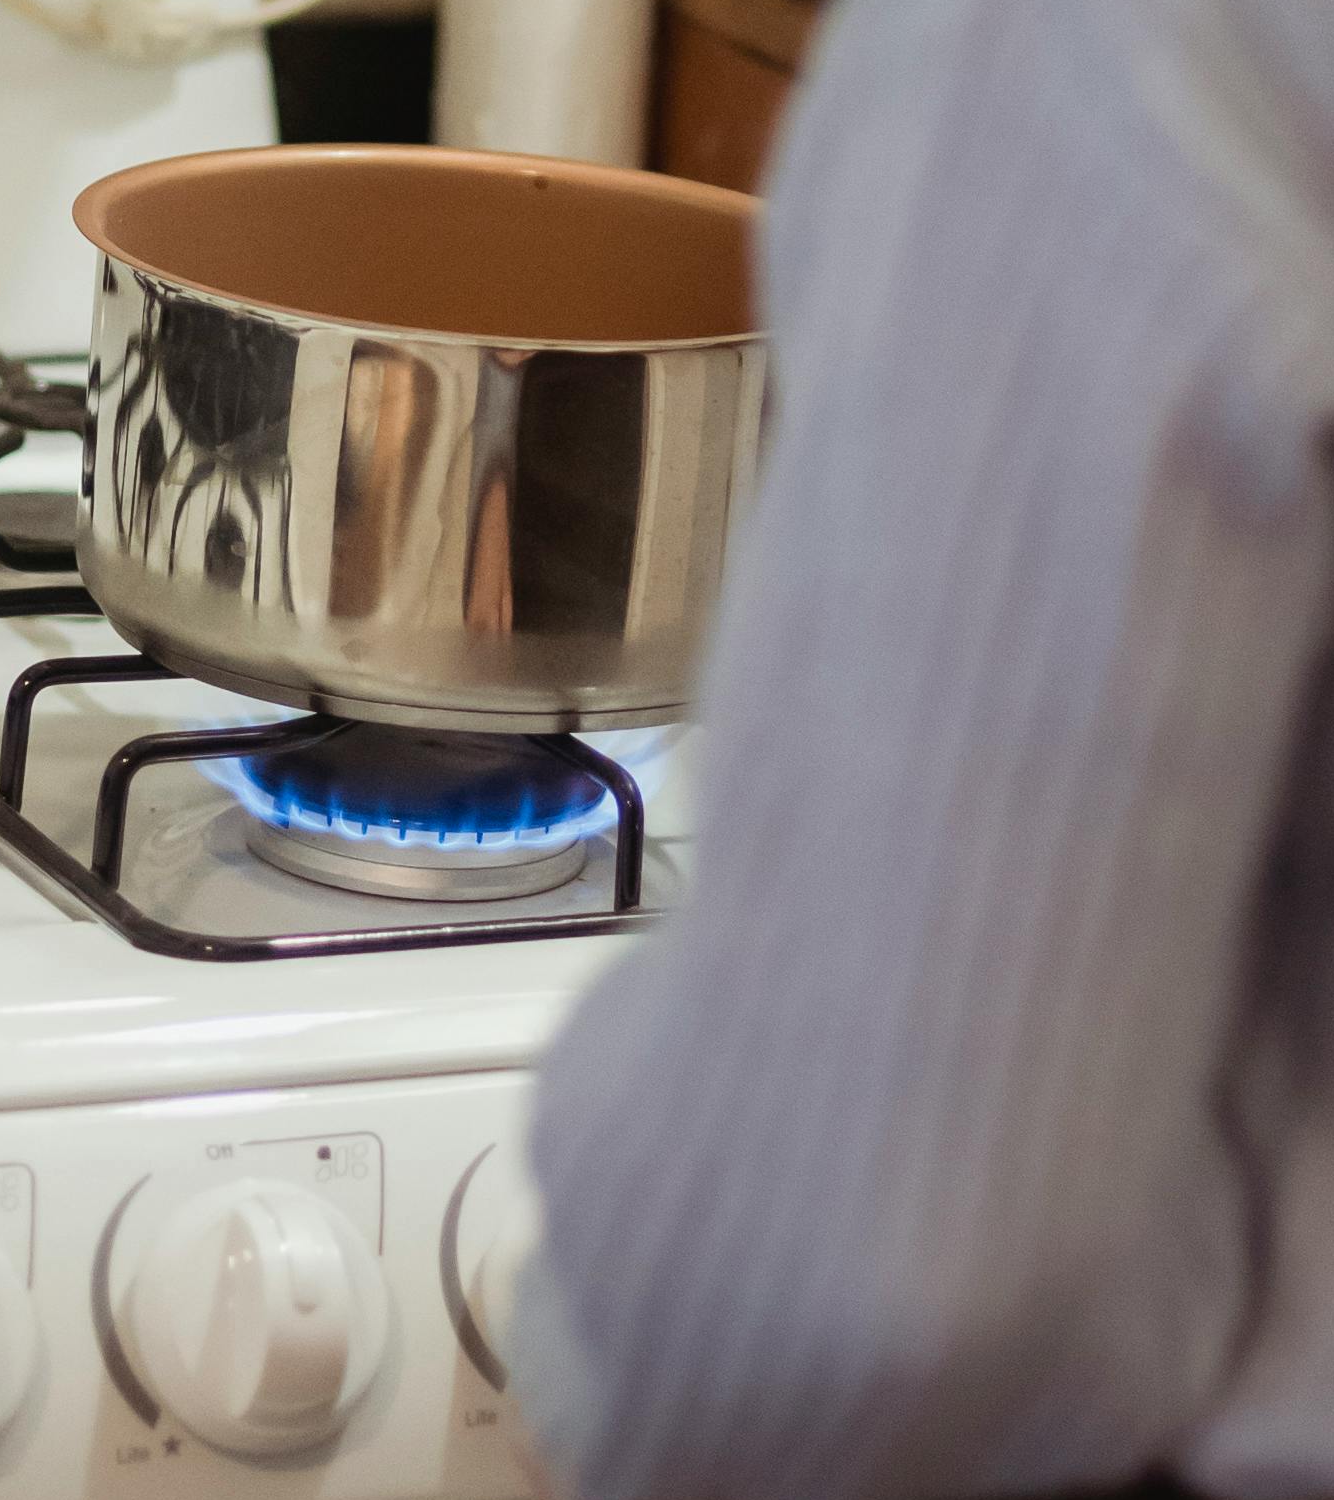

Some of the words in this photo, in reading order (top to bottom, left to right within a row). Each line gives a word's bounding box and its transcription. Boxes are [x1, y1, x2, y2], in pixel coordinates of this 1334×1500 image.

[206, 1143, 235, 1161] Off
[465, 1409, 498, 1427] Lite
[116, 1446, 151, 1466] Lite
